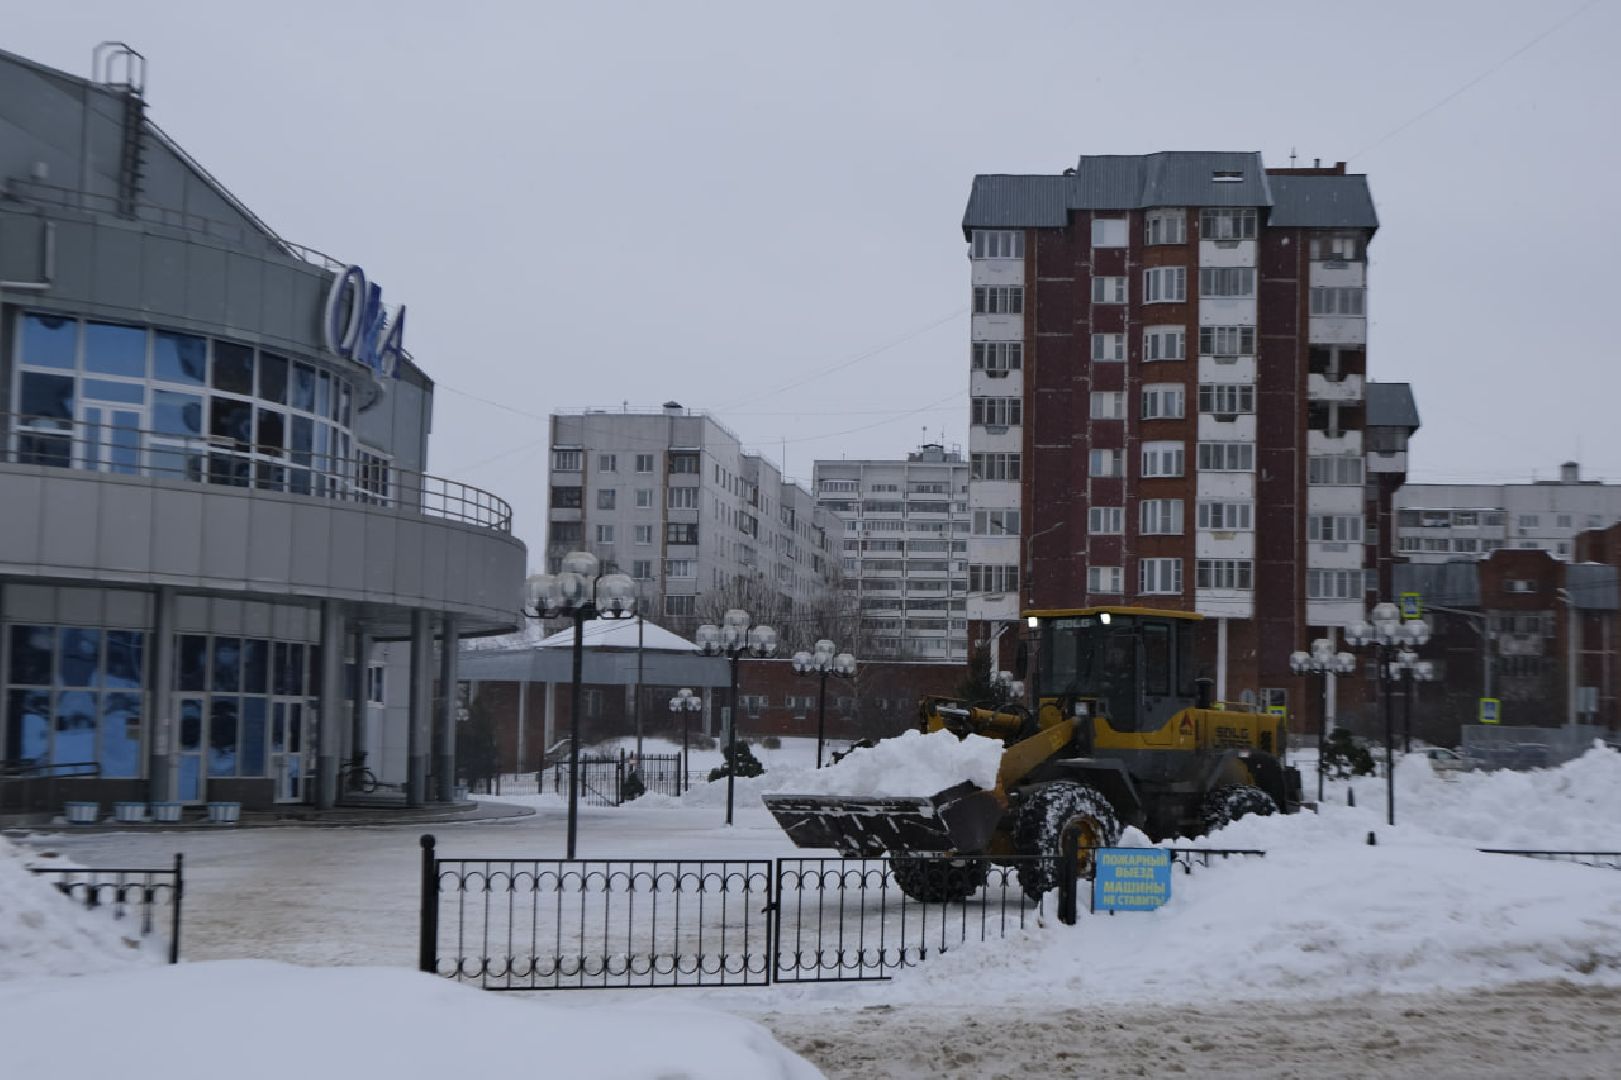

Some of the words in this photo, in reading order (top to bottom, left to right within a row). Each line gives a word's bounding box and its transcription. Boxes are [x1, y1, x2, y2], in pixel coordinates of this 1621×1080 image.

[1103, 854, 1168, 867] ПОЖАРНЫЙ
[1115, 867, 1154, 879] ВЫЕЗД
[1104, 881, 1166, 894] МАШИНЫ
[1104, 895, 1115, 905] НЕ
